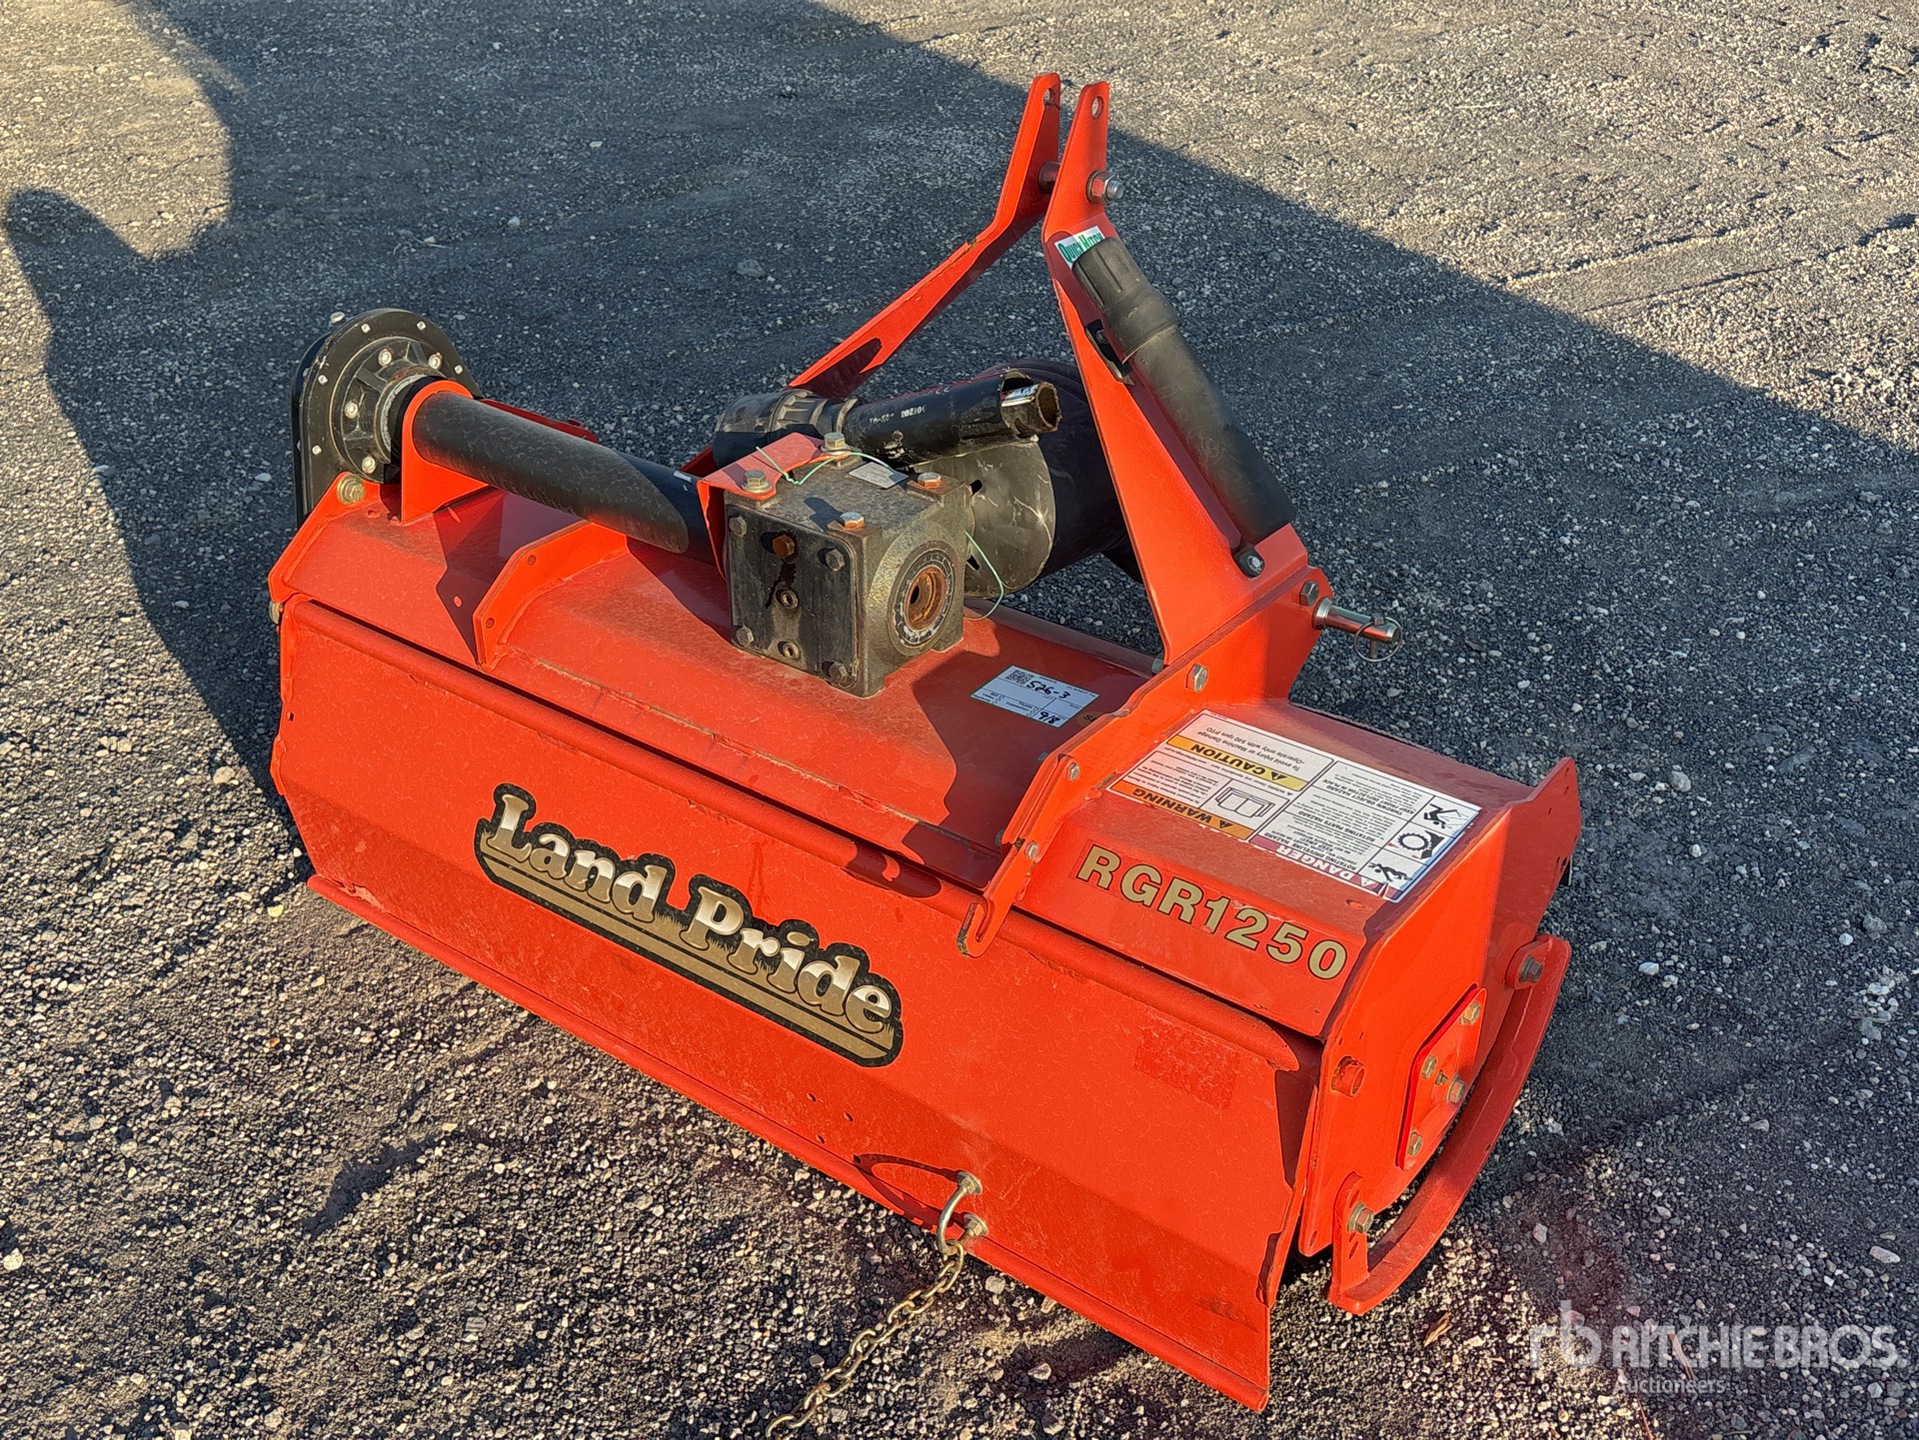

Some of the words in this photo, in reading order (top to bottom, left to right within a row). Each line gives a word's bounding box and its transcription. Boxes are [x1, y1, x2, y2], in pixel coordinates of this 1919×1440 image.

[1189, 743, 1267, 775] CAUTION
[1130, 787, 1214, 823] WARNING
[1275, 844, 1355, 879] DANGER
[487, 792, 667, 923] Land
[679, 886, 892, 1034] Pride
[1079, 844, 1348, 981] RGR1250
